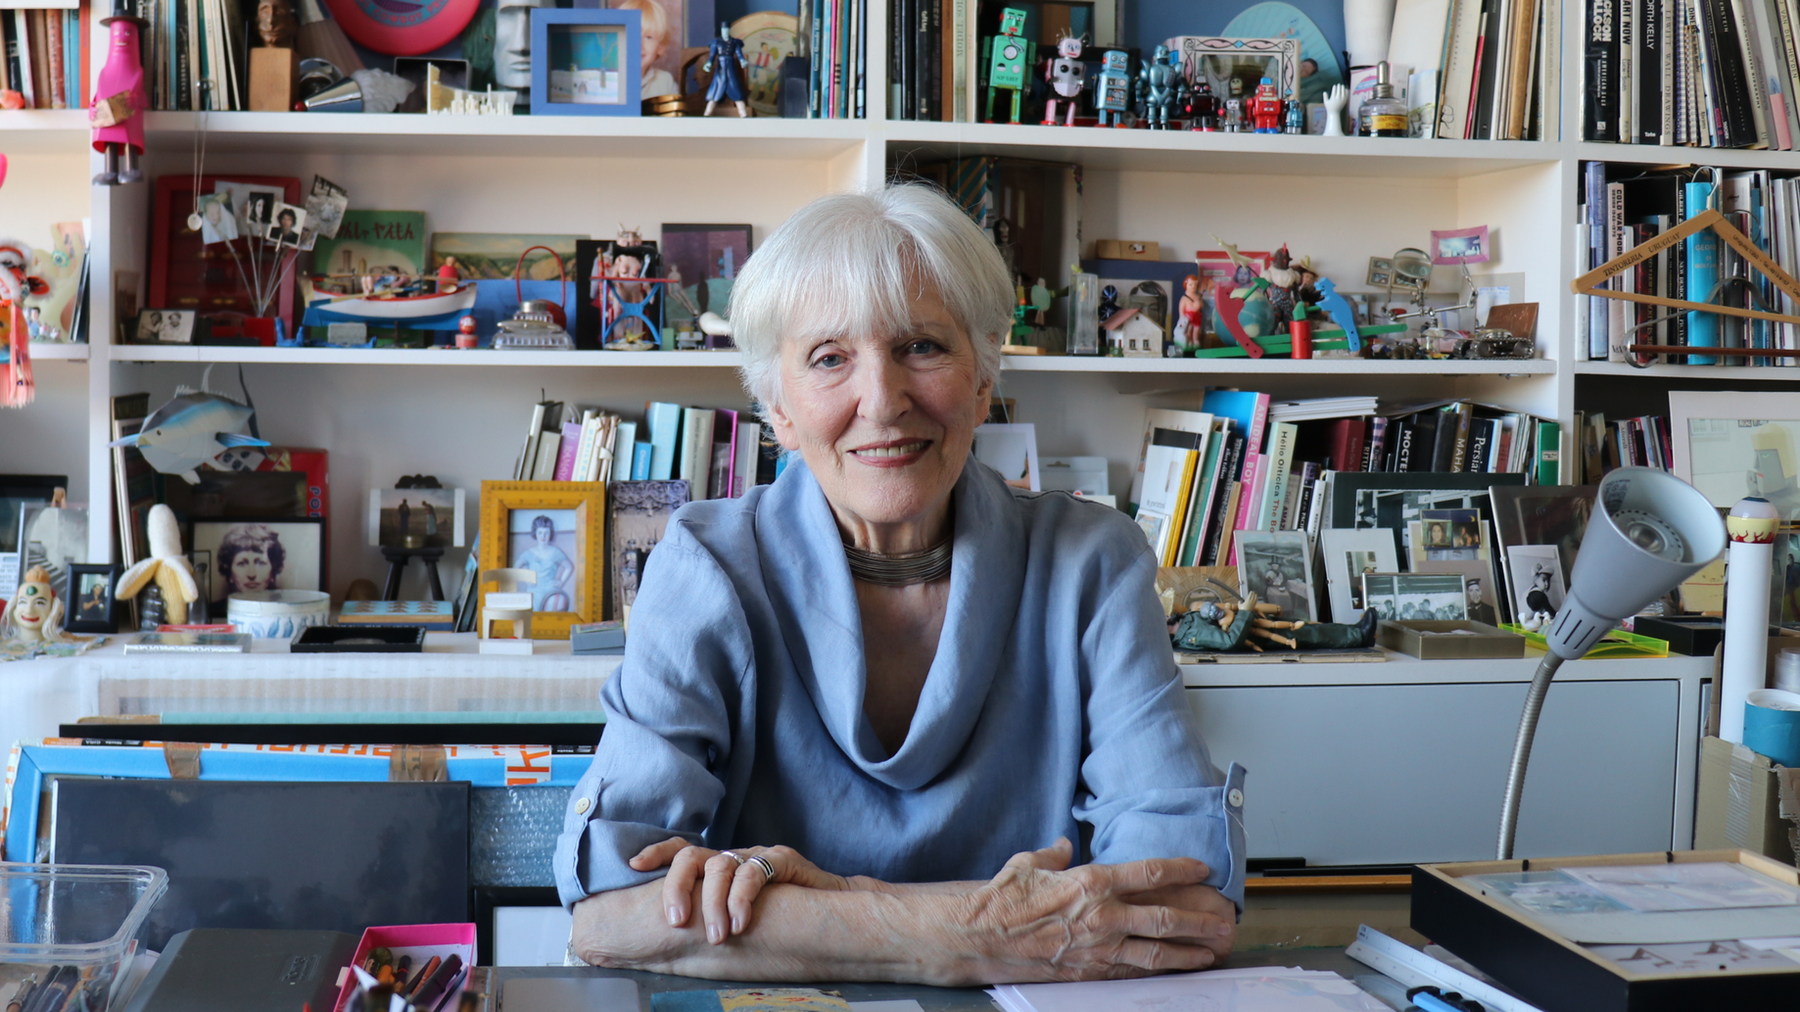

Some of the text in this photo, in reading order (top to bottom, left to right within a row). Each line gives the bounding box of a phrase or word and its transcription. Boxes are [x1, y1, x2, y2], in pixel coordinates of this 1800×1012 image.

[1602, 0, 1612, 42] CKSON
[1622, 0, 1631, 45] ART NOW
[1646, 0, 1654, 50] ORTH KELLY
[1688, 7, 1696, 34] DINERS
[1719, 1, 1728, 32] ENSTEIN
[956, 20, 964, 57] MODEL
[1788, 48, 1798, 79] HEYDEN
[1602, 231, 1681, 277] TINTORERIA URUGUAY
[1244, 404, 1265, 486] AN IDEAL BOY
[1400, 430, 1412, 473] MOCTE
[1453, 438, 1466, 473] MAHA
[1269, 430, 1288, 534] Hélio Oiticica The Bo
